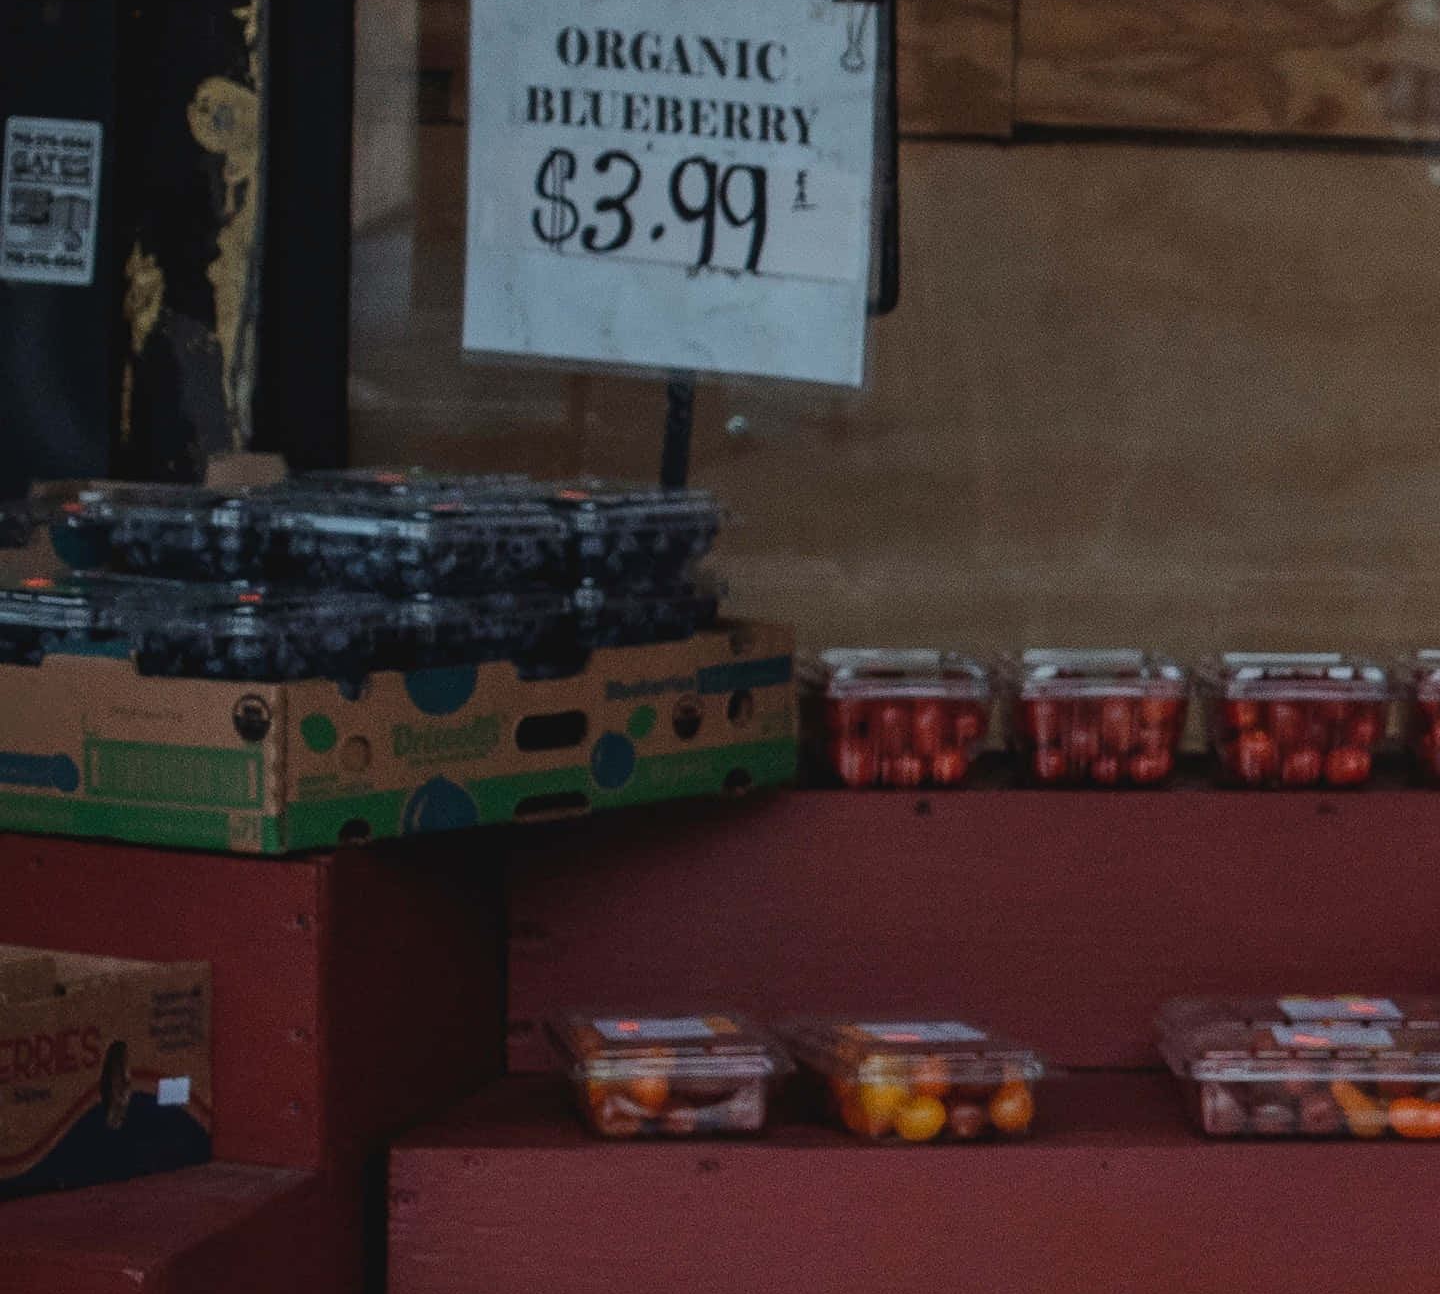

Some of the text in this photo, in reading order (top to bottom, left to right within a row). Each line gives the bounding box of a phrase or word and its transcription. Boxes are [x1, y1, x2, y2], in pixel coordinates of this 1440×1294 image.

[556, 25, 788, 83] ORGANIC
[526, 86, 820, 146] BLUEBERRY
[532, 148, 767, 275] $3.99
